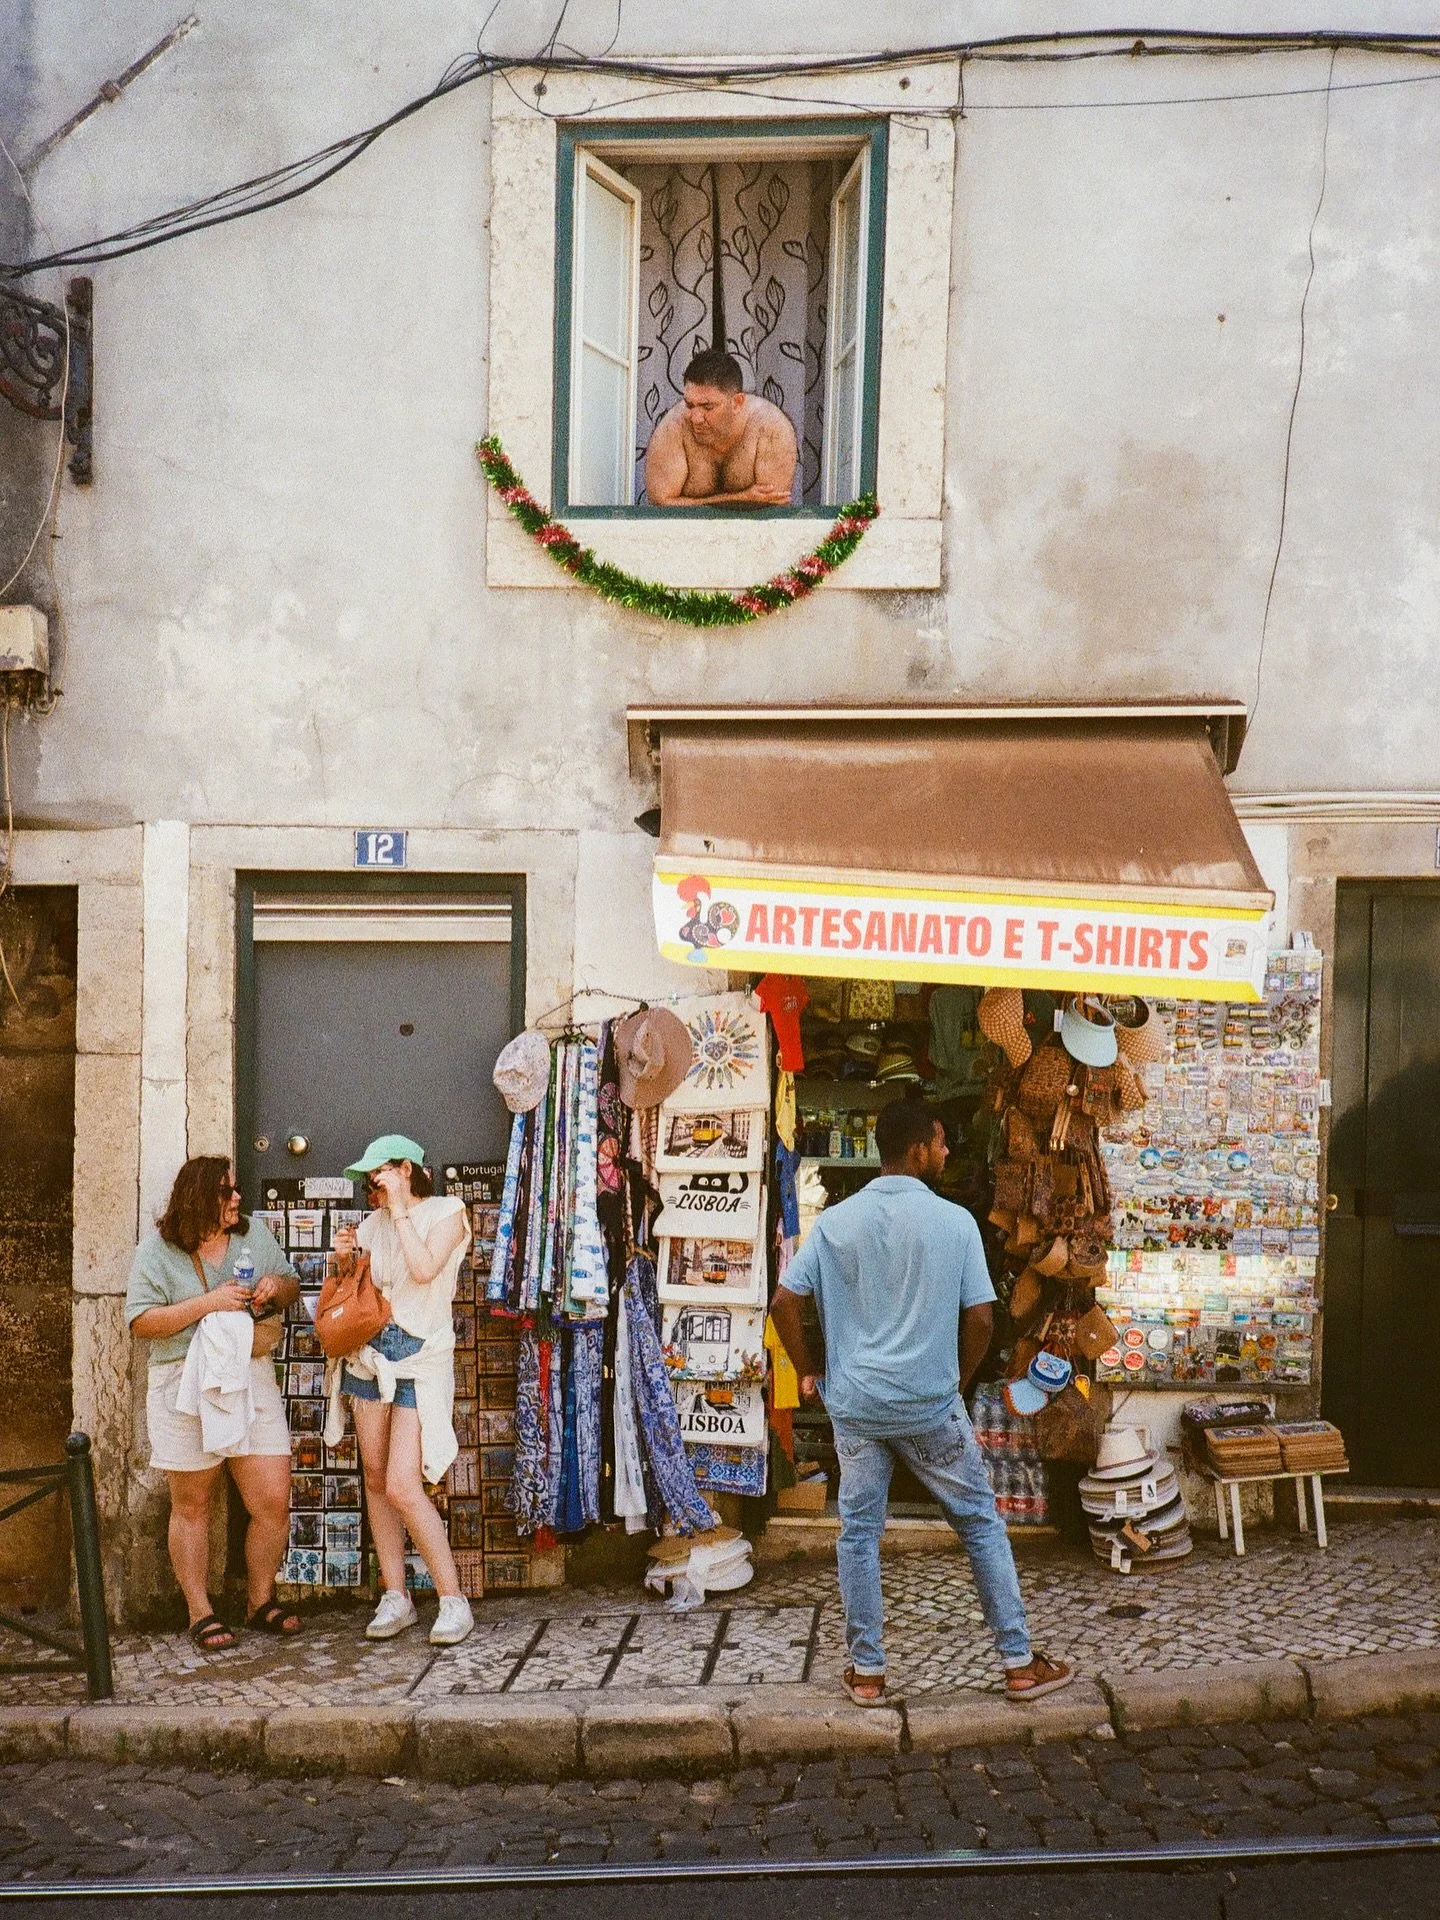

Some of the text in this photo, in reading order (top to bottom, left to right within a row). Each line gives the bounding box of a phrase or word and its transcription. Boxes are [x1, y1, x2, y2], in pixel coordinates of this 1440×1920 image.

[367, 834, 394, 864] 12
[745, 903, 1209, 971] ARTESANATO E T-SHIRTS
[462, 1164, 505, 1177] Portugal
[675, 1193, 741, 1212] LISBOA
[677, 1413, 746, 1434] LISBOA
